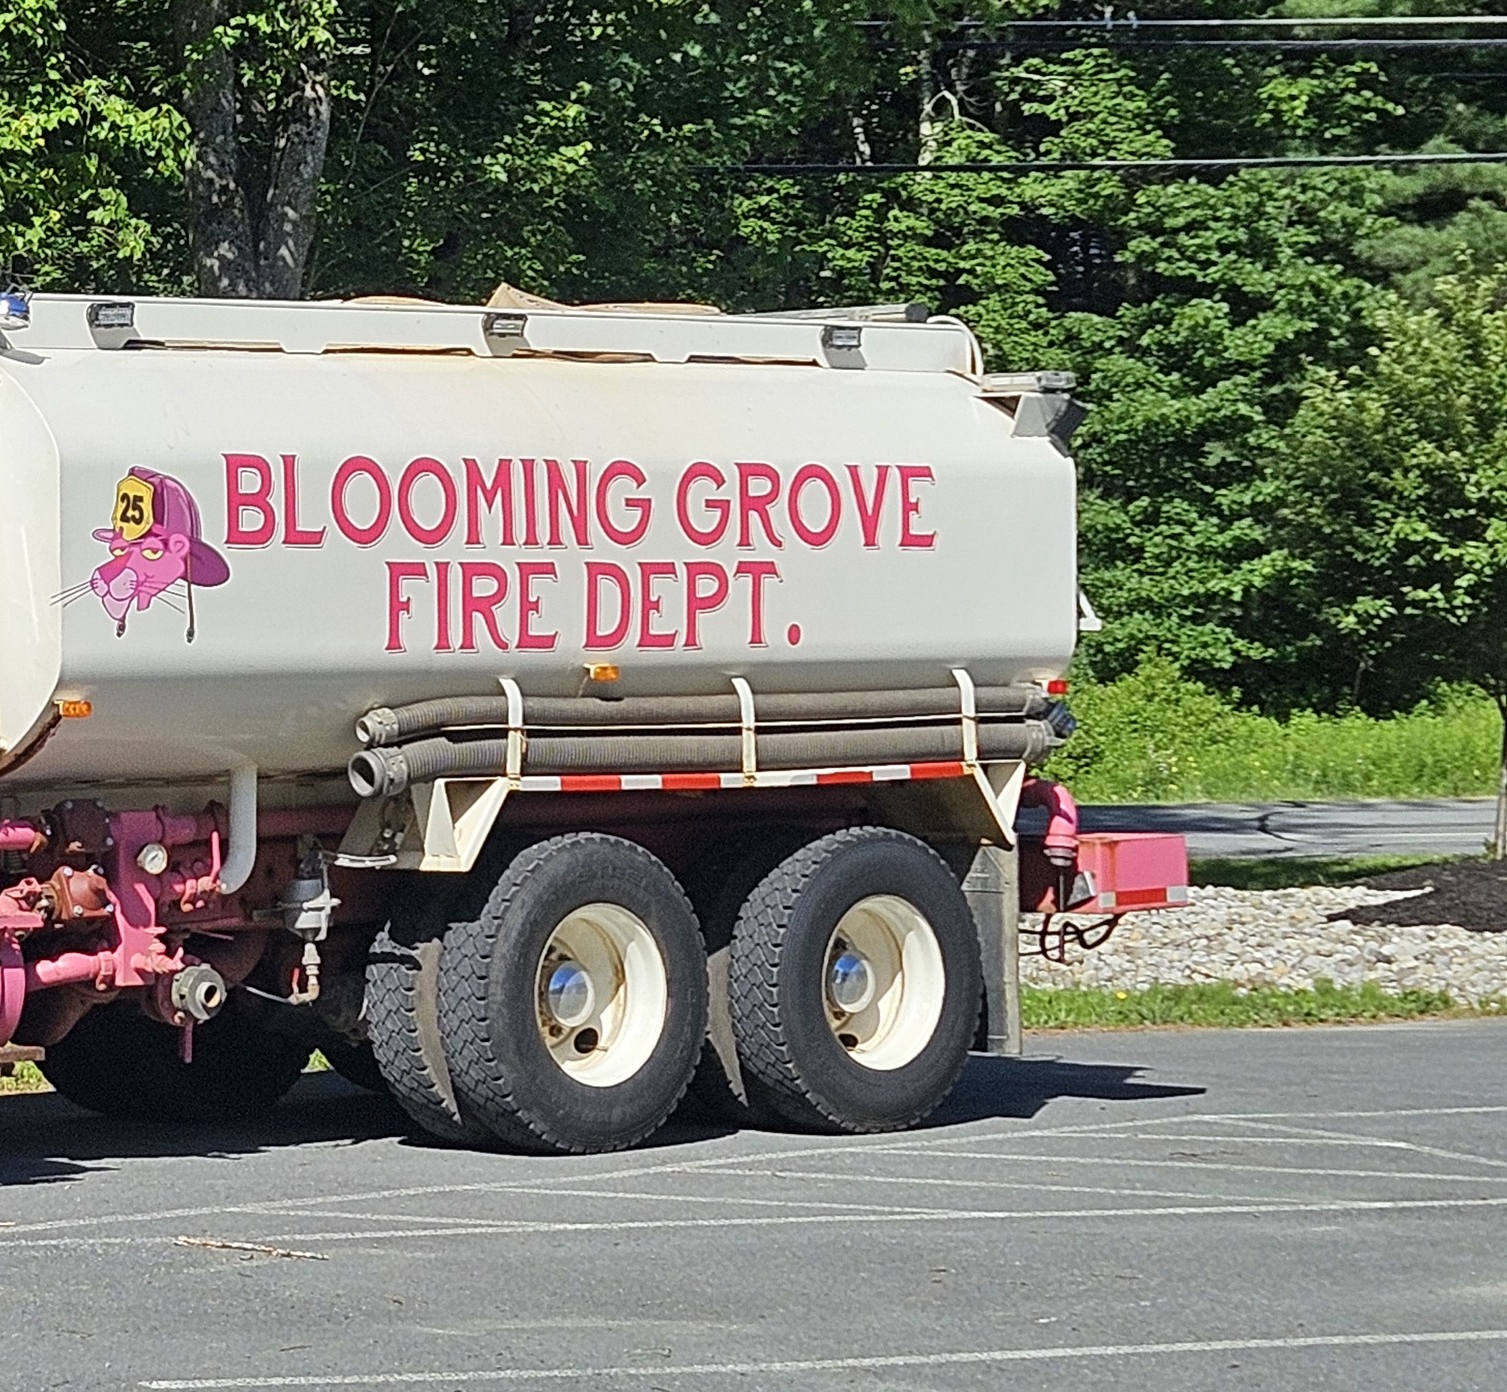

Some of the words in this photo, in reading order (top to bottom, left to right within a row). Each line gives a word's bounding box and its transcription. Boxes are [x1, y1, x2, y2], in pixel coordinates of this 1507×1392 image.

[119, 492, 144, 526] 25
[222, 453, 655, 549] BLOOMING
[675, 461, 937, 550] GROVE
[384, 561, 560, 652] FIRE
[581, 561, 803, 651] DEPT.
